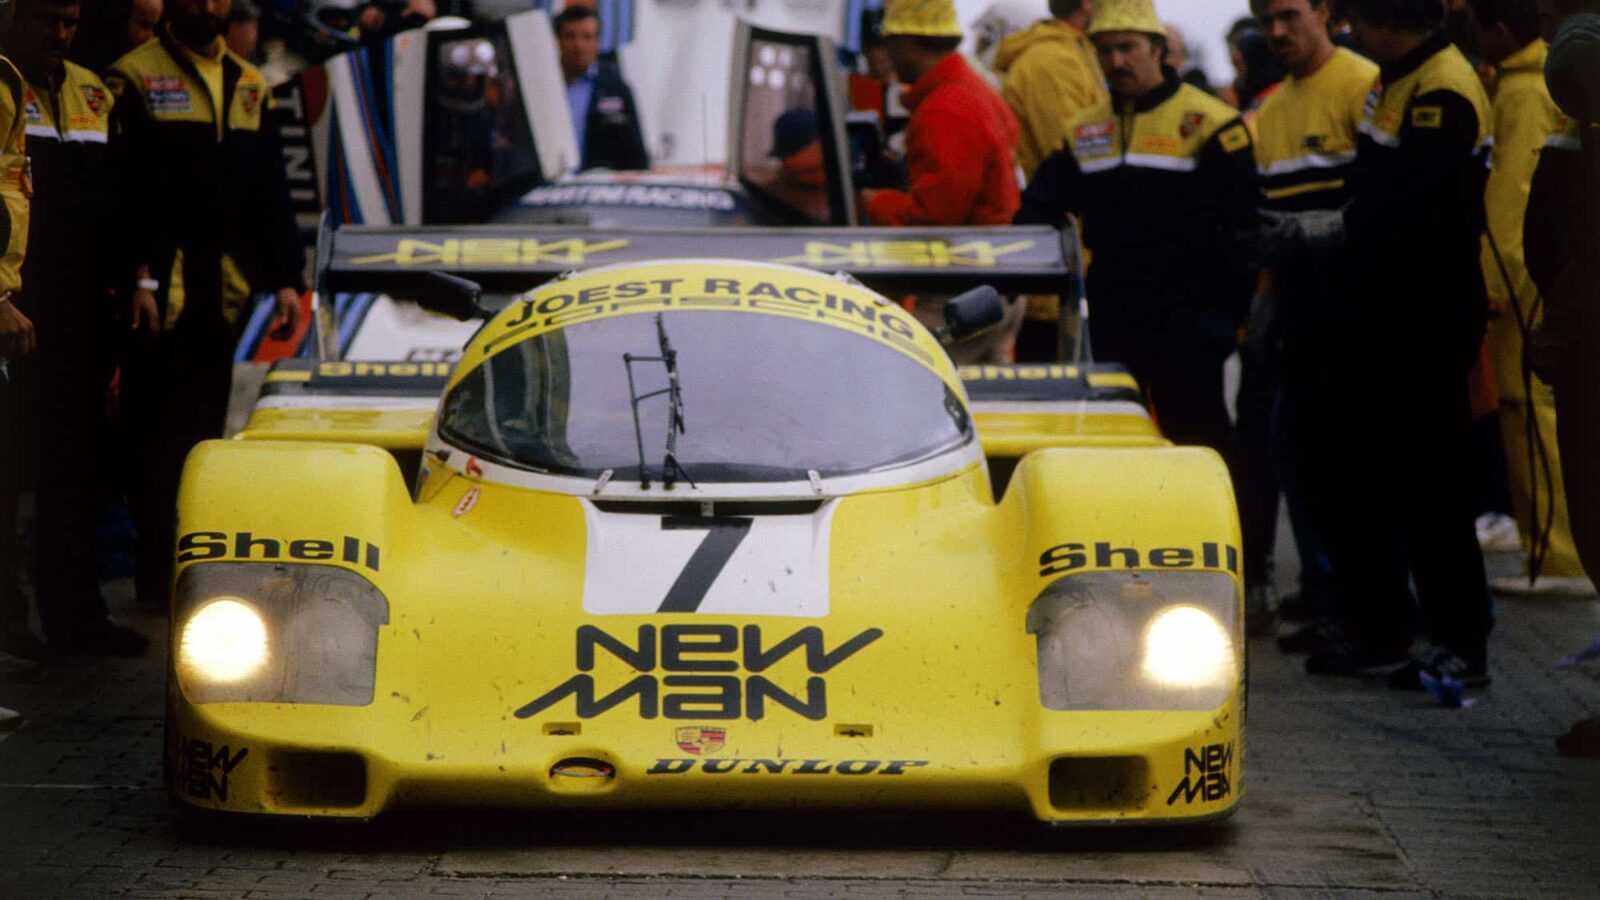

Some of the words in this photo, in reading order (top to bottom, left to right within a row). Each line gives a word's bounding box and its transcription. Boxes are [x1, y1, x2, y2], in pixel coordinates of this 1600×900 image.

[506, 279, 684, 327] JOEST
[704, 278, 914, 339] RACING
[319, 362, 450, 378] Shell
[178, 532, 380, 571] Shell
[656, 517, 754, 613] 7
[1040, 542, 1237, 576] Shell
[646, 758, 930, 775] DUNLOP
